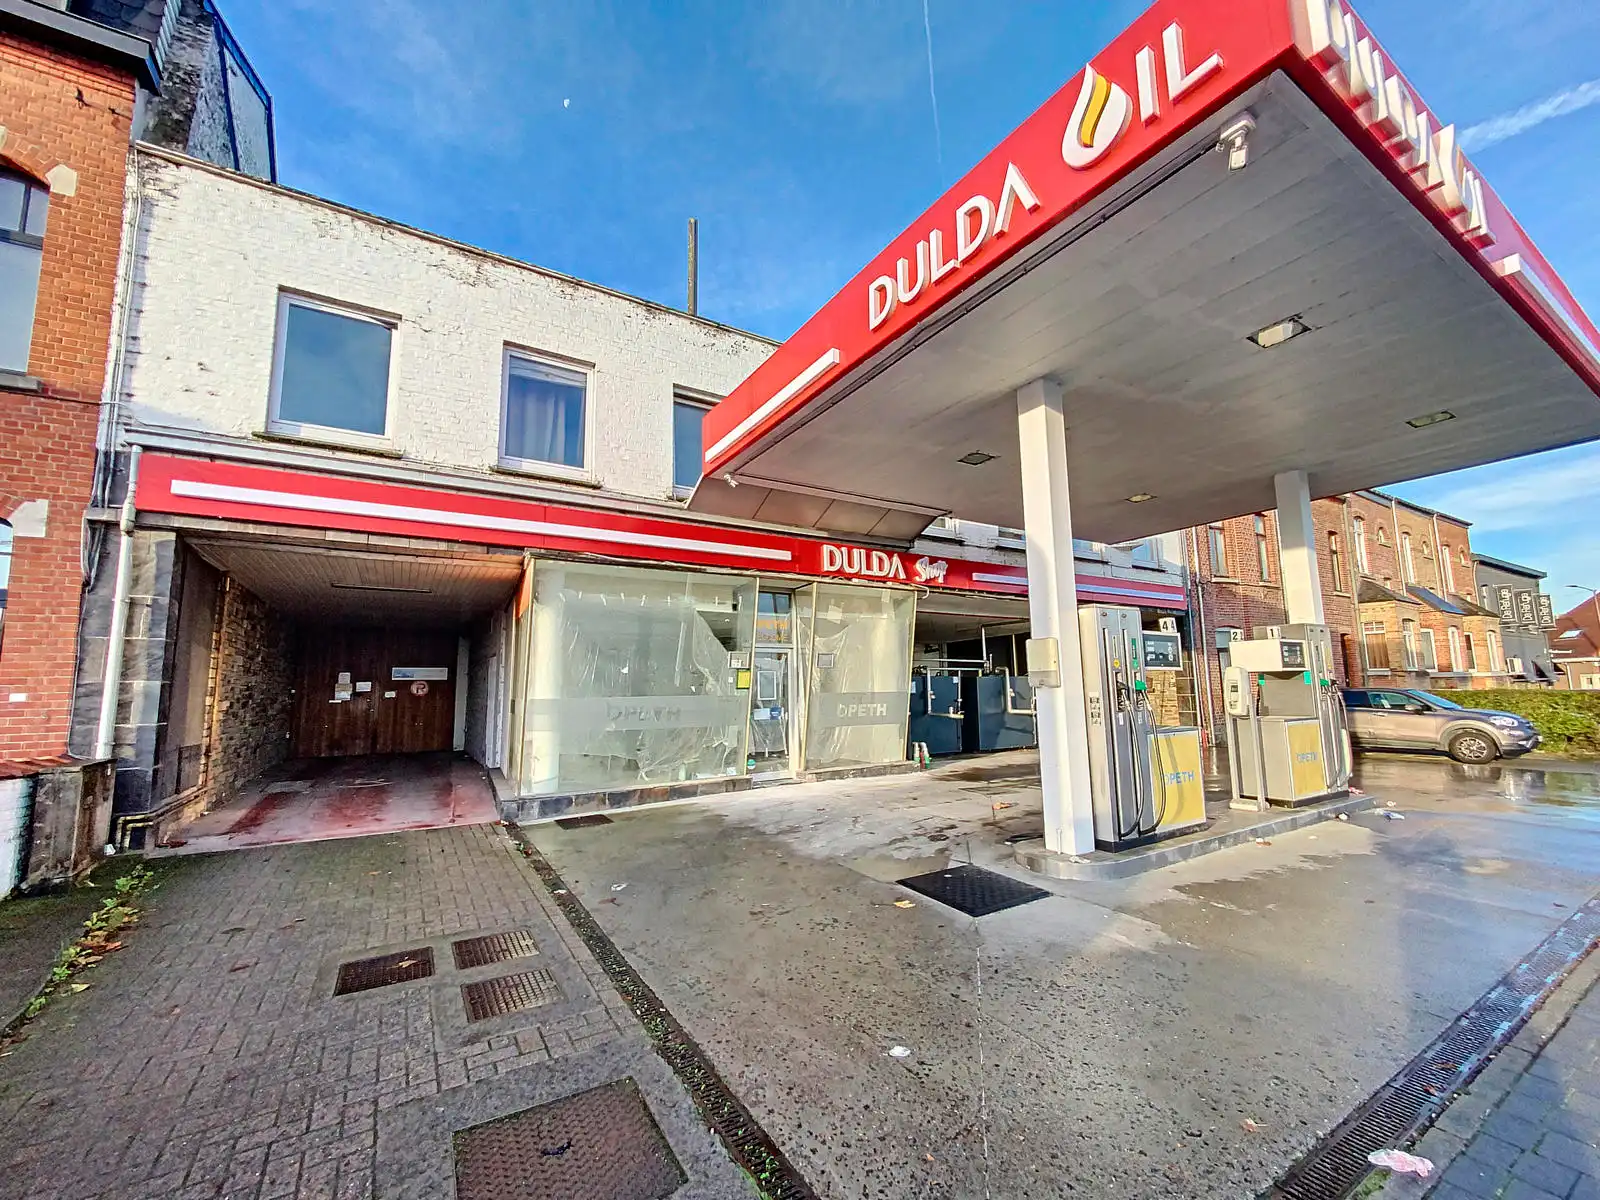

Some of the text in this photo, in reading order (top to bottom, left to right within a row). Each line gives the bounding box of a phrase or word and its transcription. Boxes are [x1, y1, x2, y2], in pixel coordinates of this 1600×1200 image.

[867, 160, 1041, 331] DULDA
[820, 544, 949, 583] DULDA Shop
[1162, 620, 1169, 631] 4
[1232, 631, 1238, 641] 2
